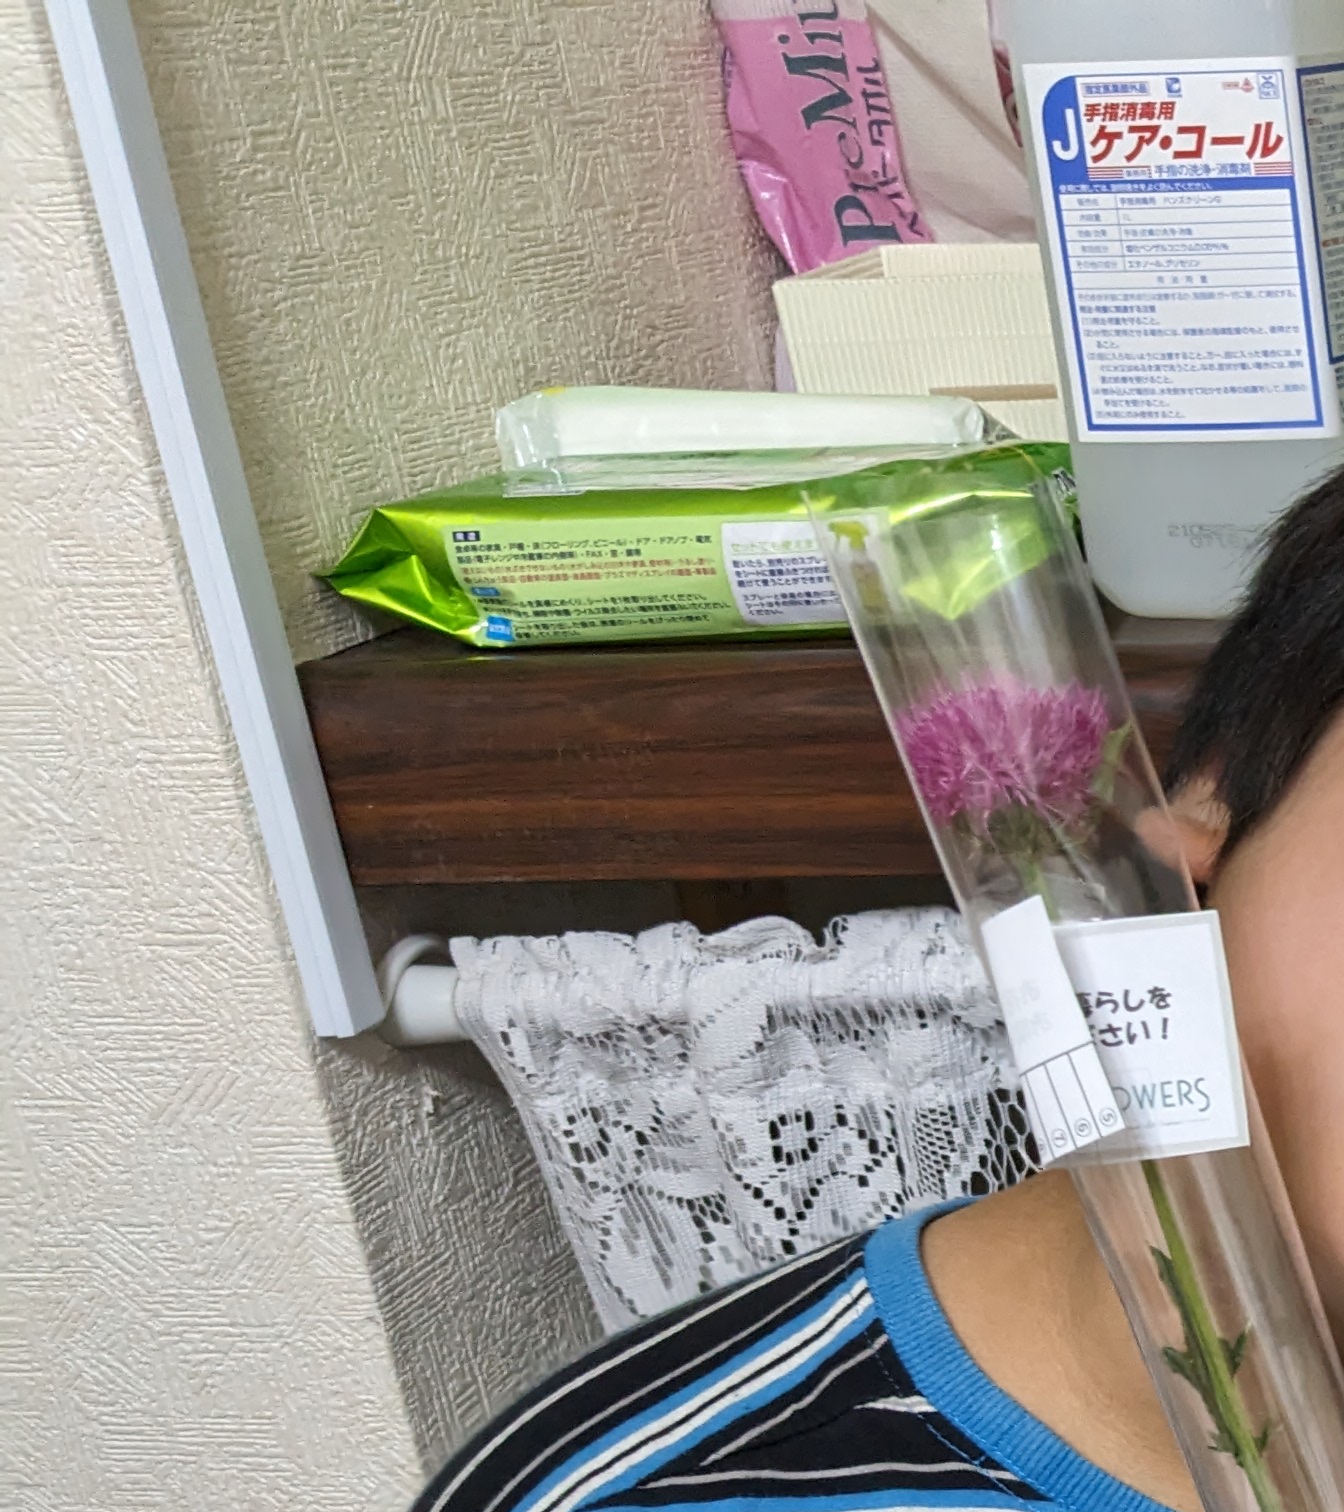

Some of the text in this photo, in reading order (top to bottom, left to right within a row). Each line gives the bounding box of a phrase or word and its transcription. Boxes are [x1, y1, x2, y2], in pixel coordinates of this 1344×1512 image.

[1084, 101, 1175, 122] 手指消毒用
[1052, 108, 1079, 161] J
[1090, 121, 1284, 164] ケア・コール
[1089, 1017, 1169, 1046] さい！
